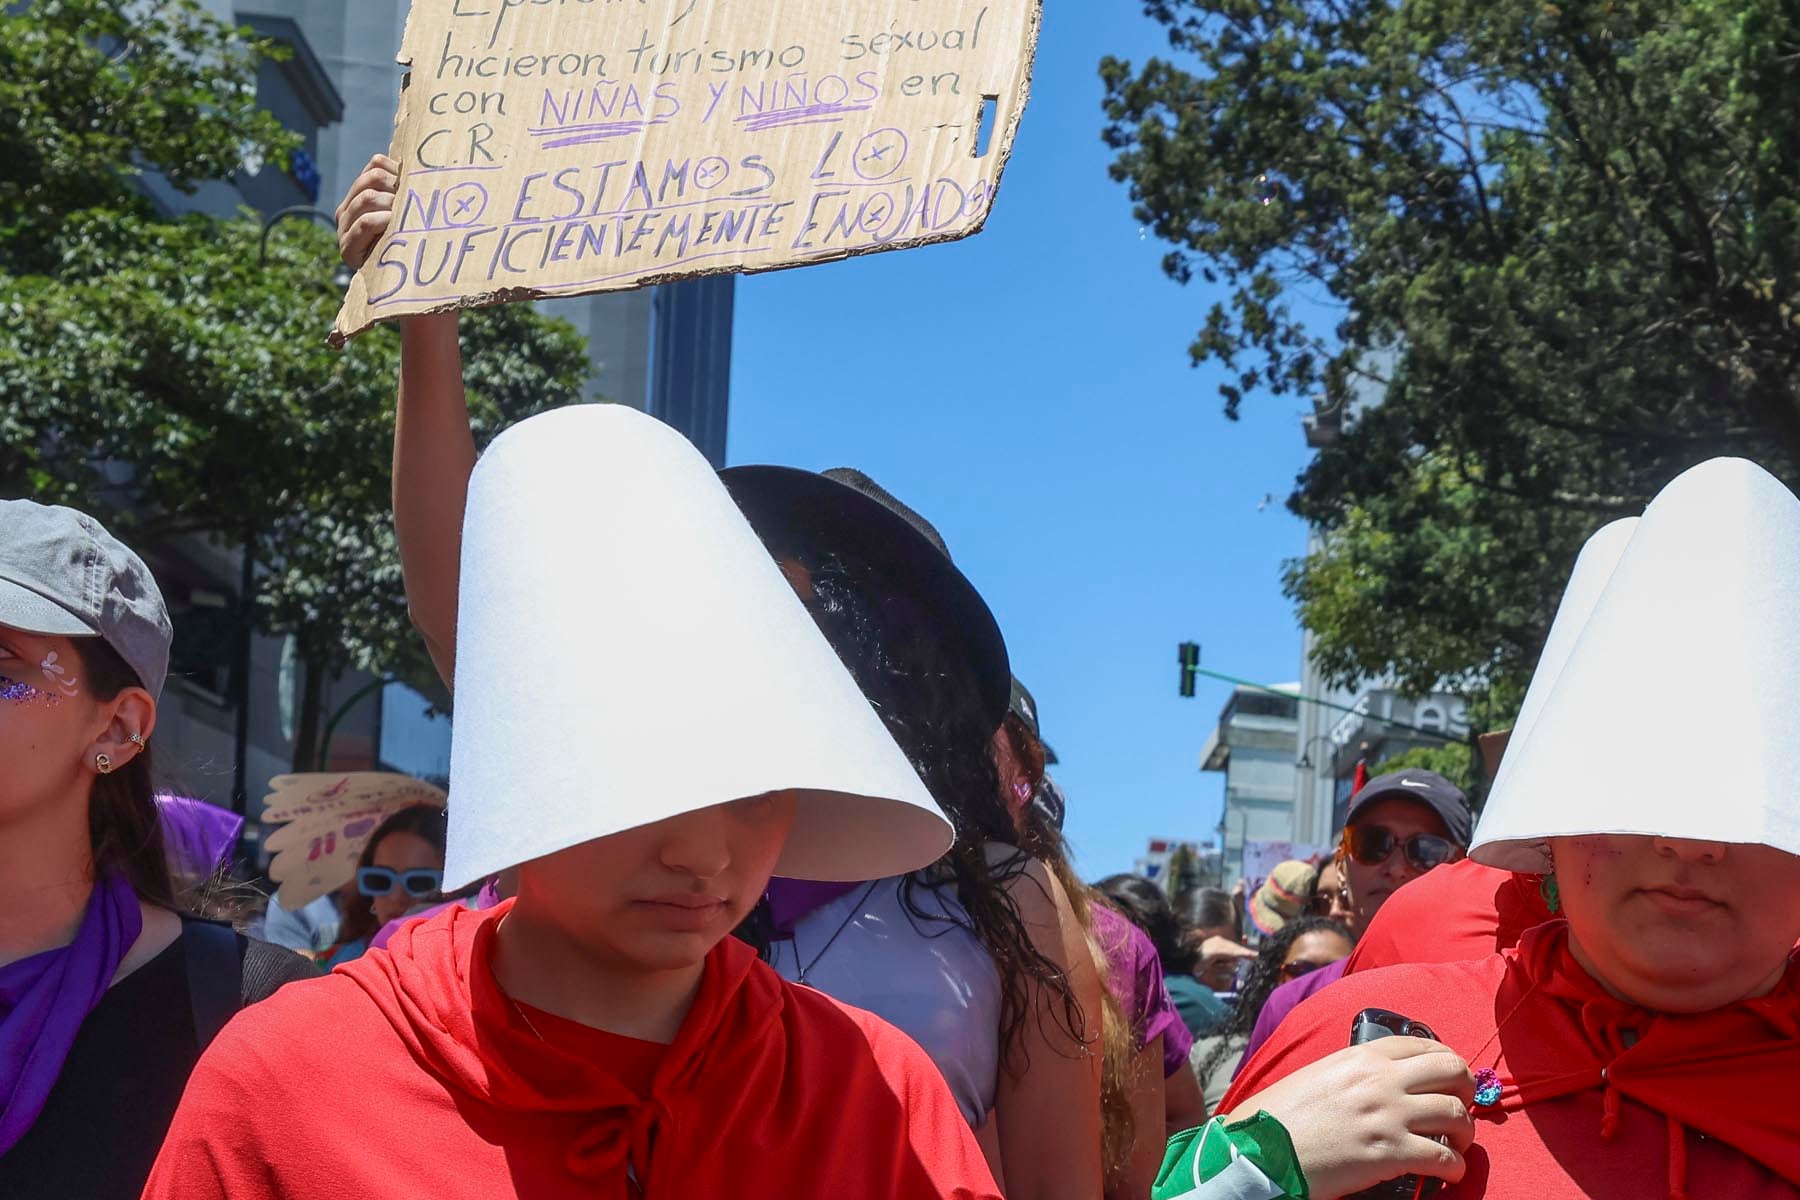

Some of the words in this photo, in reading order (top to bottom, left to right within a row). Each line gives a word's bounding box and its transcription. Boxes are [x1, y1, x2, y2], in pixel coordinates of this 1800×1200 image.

[436, 31, 608, 80] hicieron
[628, 29, 806, 74] turismo
[840, 12, 982, 61] sexual
[428, 86, 506, 116] con
[540, 80, 680, 126] NIÑAS
[738, 70, 880, 115] NIÑOS
[899, 68, 961, 97] en
[399, 181, 488, 233] NO
[517, 153, 776, 223] ESTAMOS
[810, 128, 908, 181] LO
[367, 202, 783, 304] SUFICIENTEMENTE
[792, 178, 993, 239] ENOJADO
